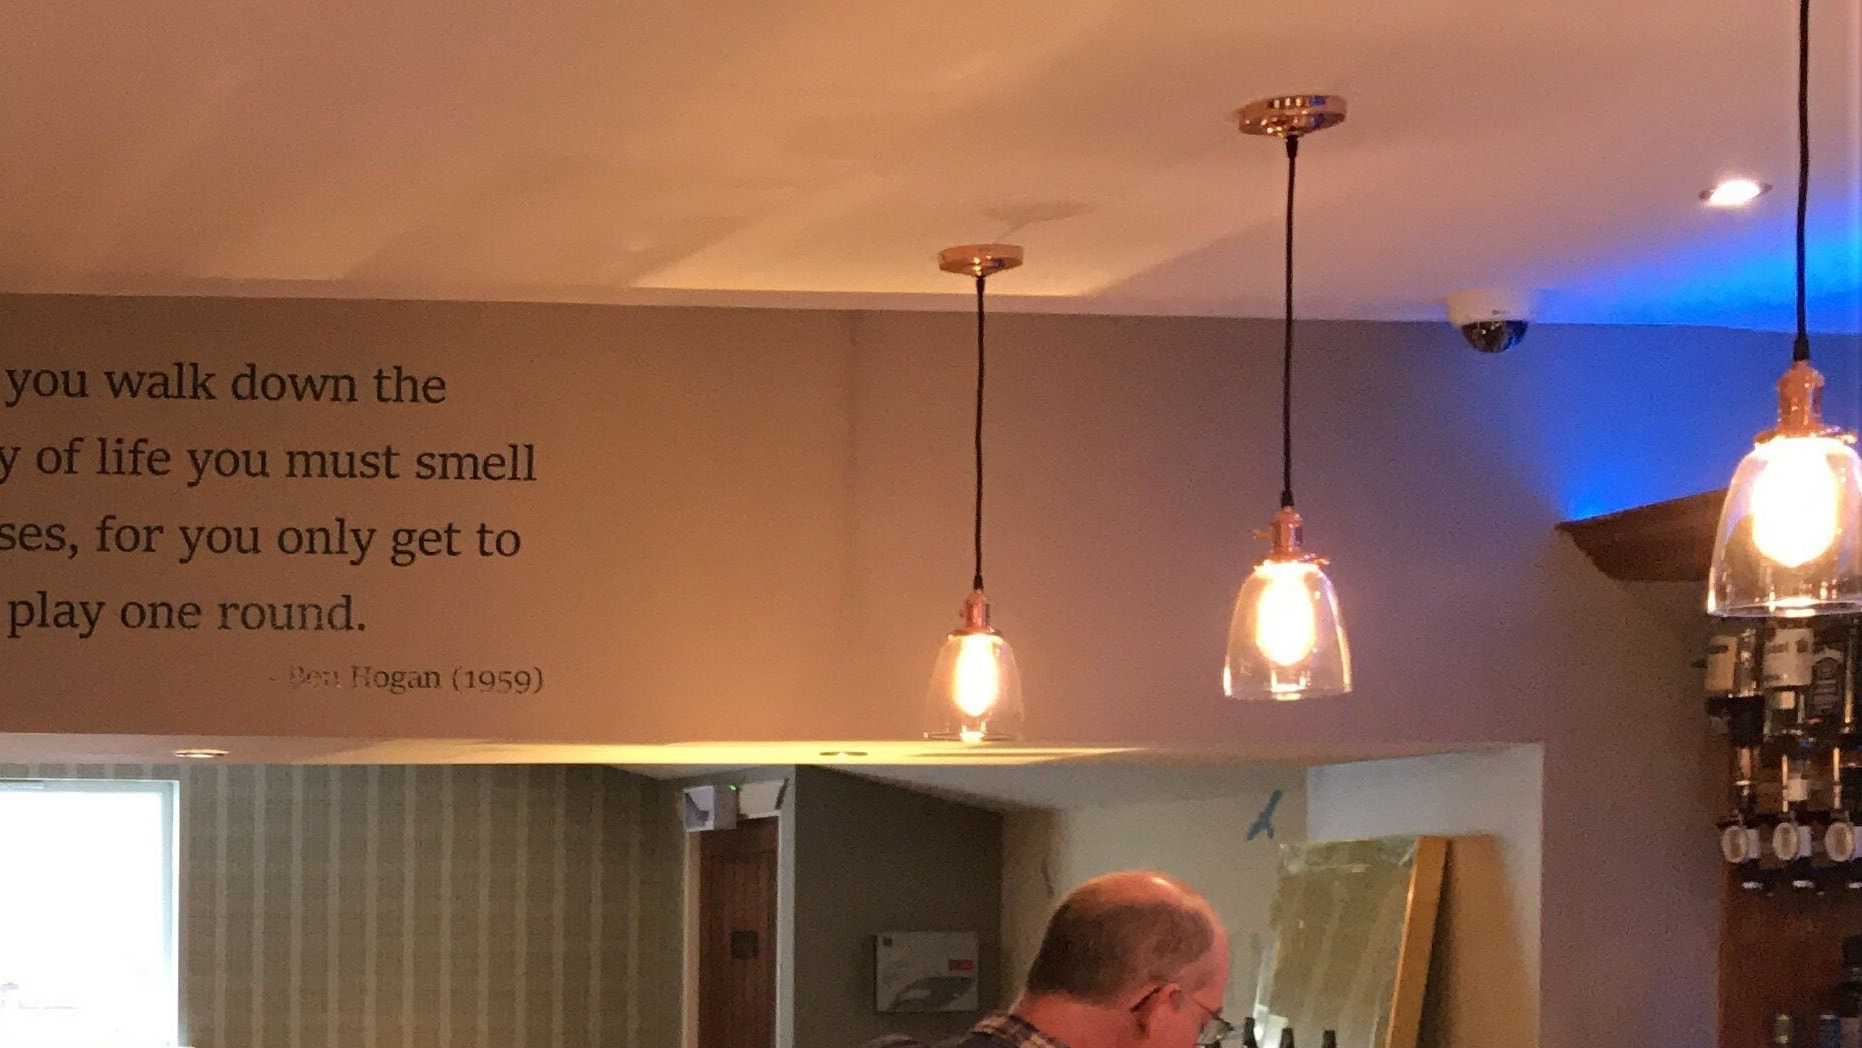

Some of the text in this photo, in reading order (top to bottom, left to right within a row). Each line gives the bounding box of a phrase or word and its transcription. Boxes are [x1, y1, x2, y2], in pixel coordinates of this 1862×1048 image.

[4, 368, 90, 409] you
[102, 360, 218, 401] walk
[230, 362, 359, 405] down
[372, 364, 447, 405] the
[35, 436, 85, 476] of
[95, 436, 172, 477] life
[185, 447, 271, 489] you
[284, 443, 401, 481] must
[414, 442, 538, 483] smell
[95, 513, 165, 554] for
[177, 524, 263, 565] you
[276, 516, 378, 567] only
[389, 521, 463, 568] get
[475, 521, 522, 558] to
[6, 589, 367, 640] play one round.
[350, 665, 442, 695] Hogan
[452, 666, 544, 694] (1959)
